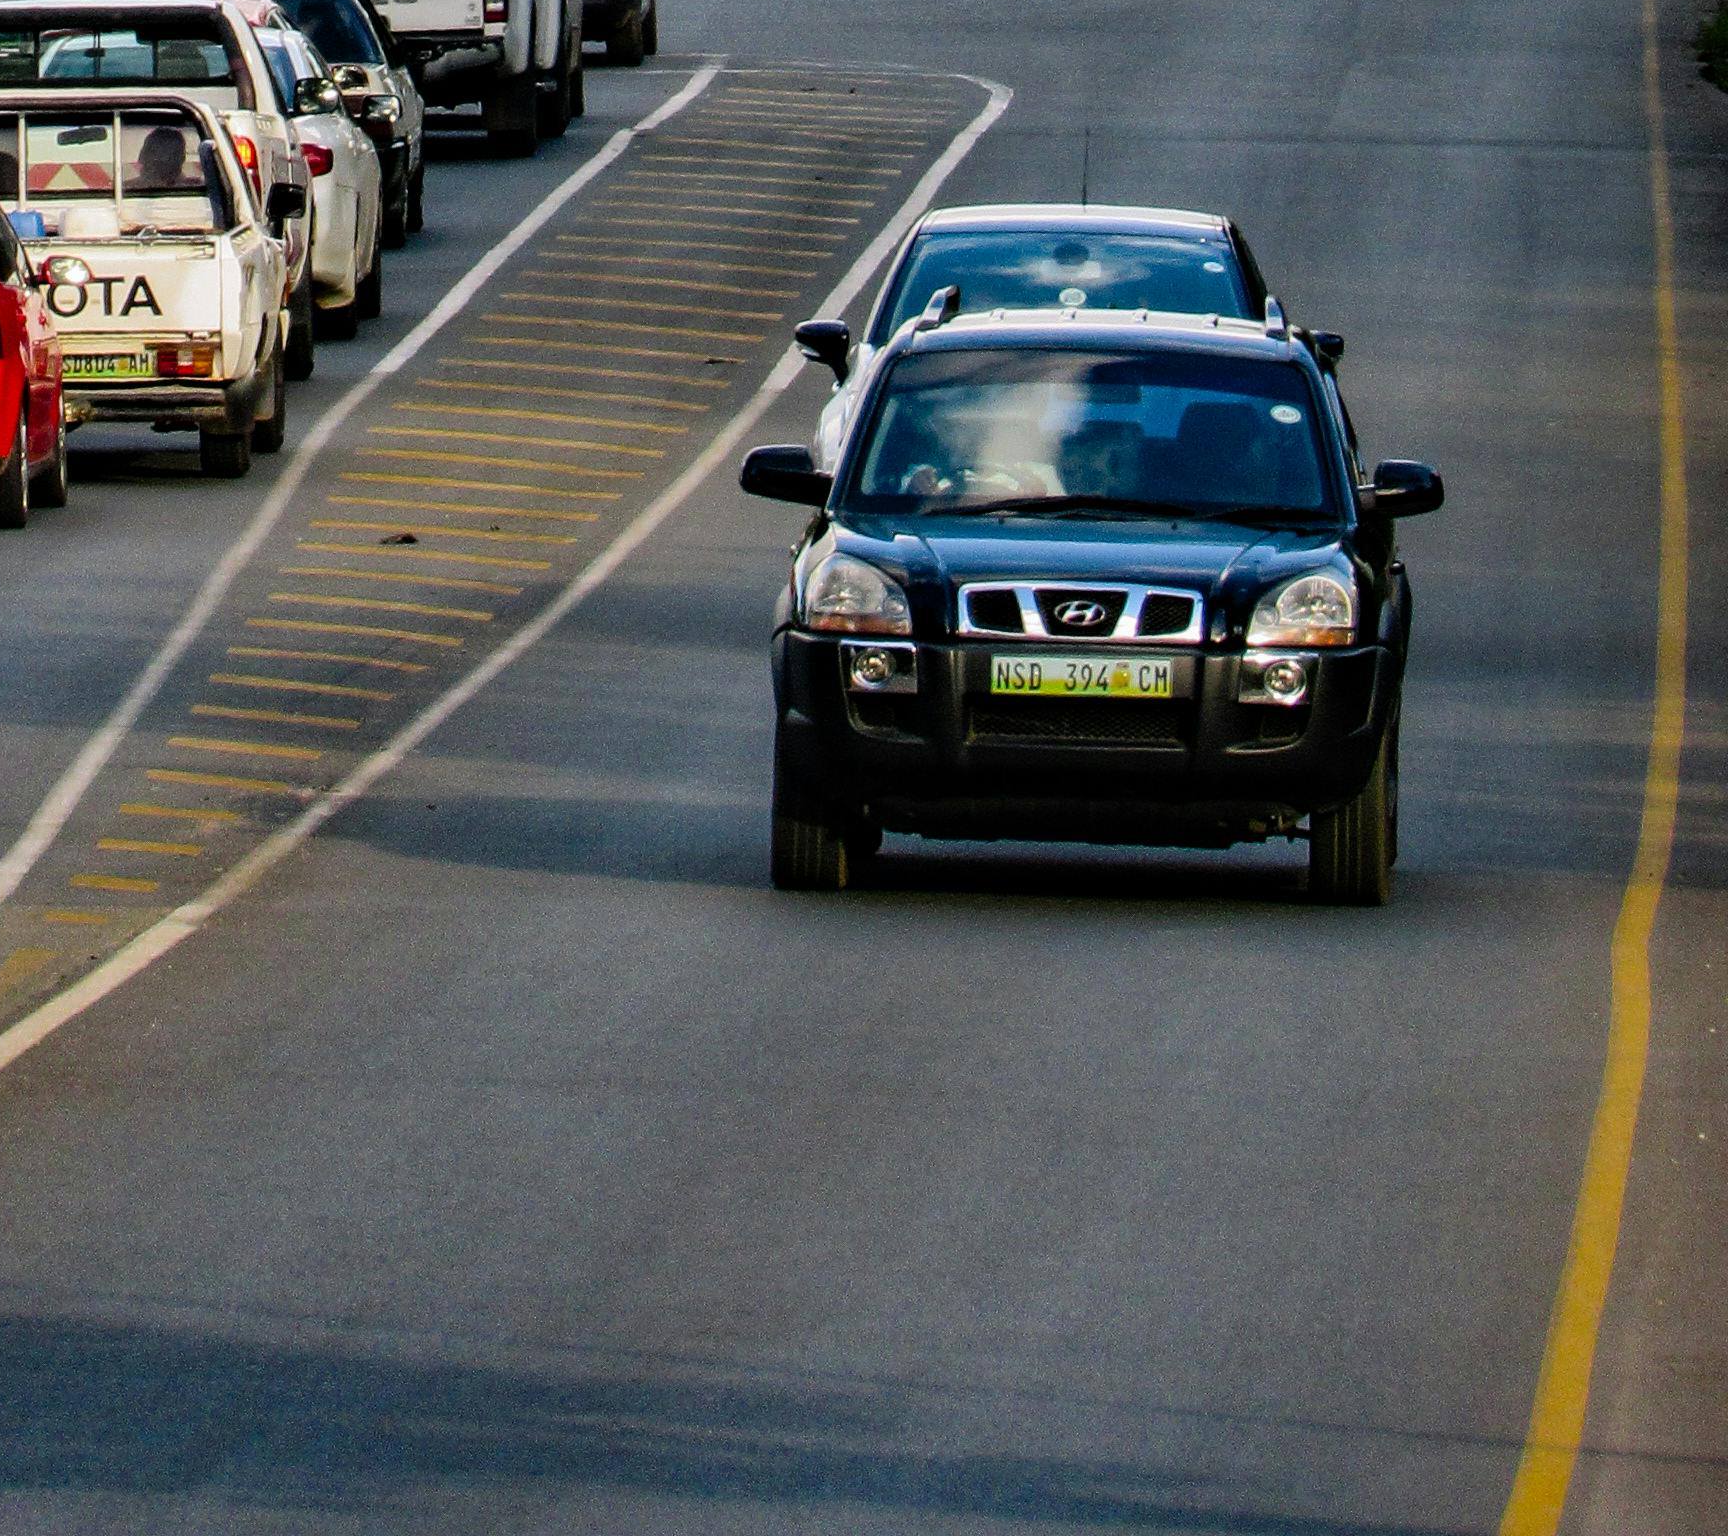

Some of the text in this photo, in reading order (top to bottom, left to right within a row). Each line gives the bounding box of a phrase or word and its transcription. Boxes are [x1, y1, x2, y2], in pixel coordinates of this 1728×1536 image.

[46, 275, 163, 318] OTA
[996, 661, 1168, 693] NSD 394 CM
